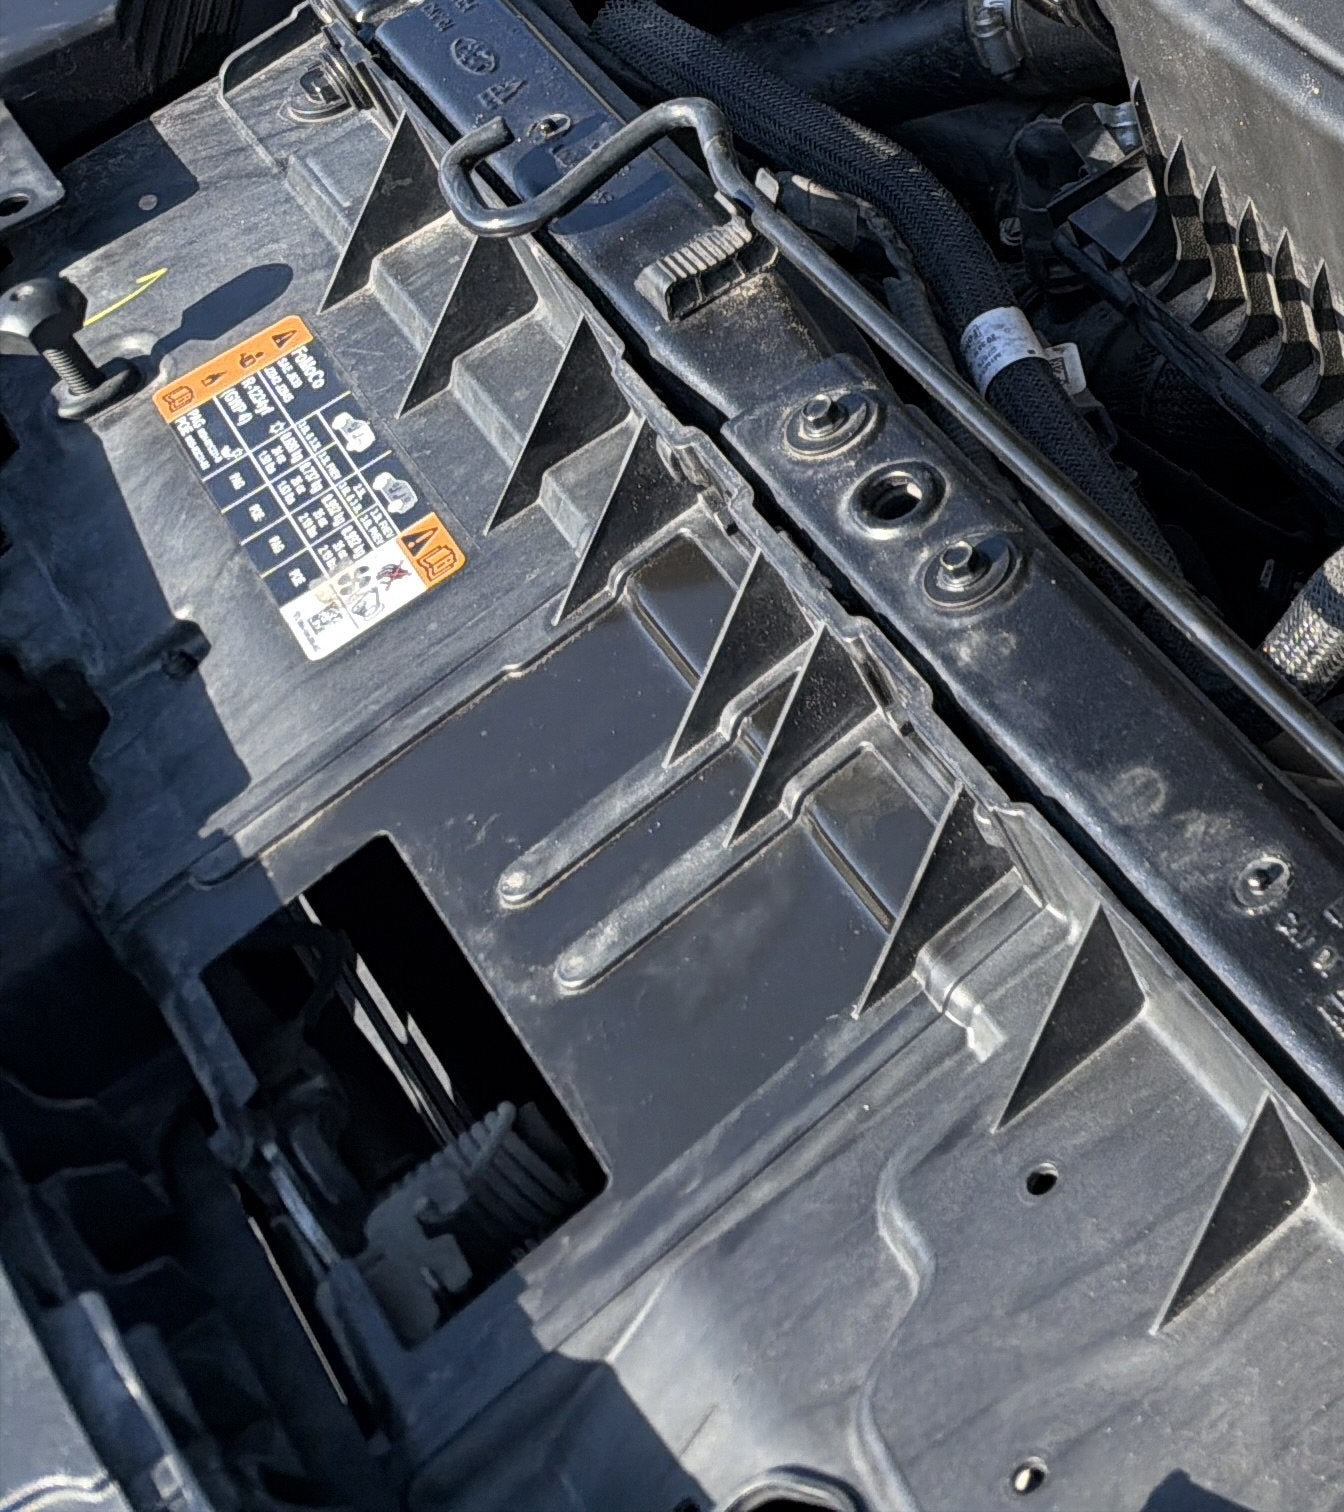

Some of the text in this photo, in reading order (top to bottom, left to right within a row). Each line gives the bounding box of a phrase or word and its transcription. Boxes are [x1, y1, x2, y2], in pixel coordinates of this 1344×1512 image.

[290, 344, 328, 391] FoMoCo
[239, 375, 274, 418] R-1234yf
[173, 415, 194, 437] POE
[185, 407, 206, 429] PAG
